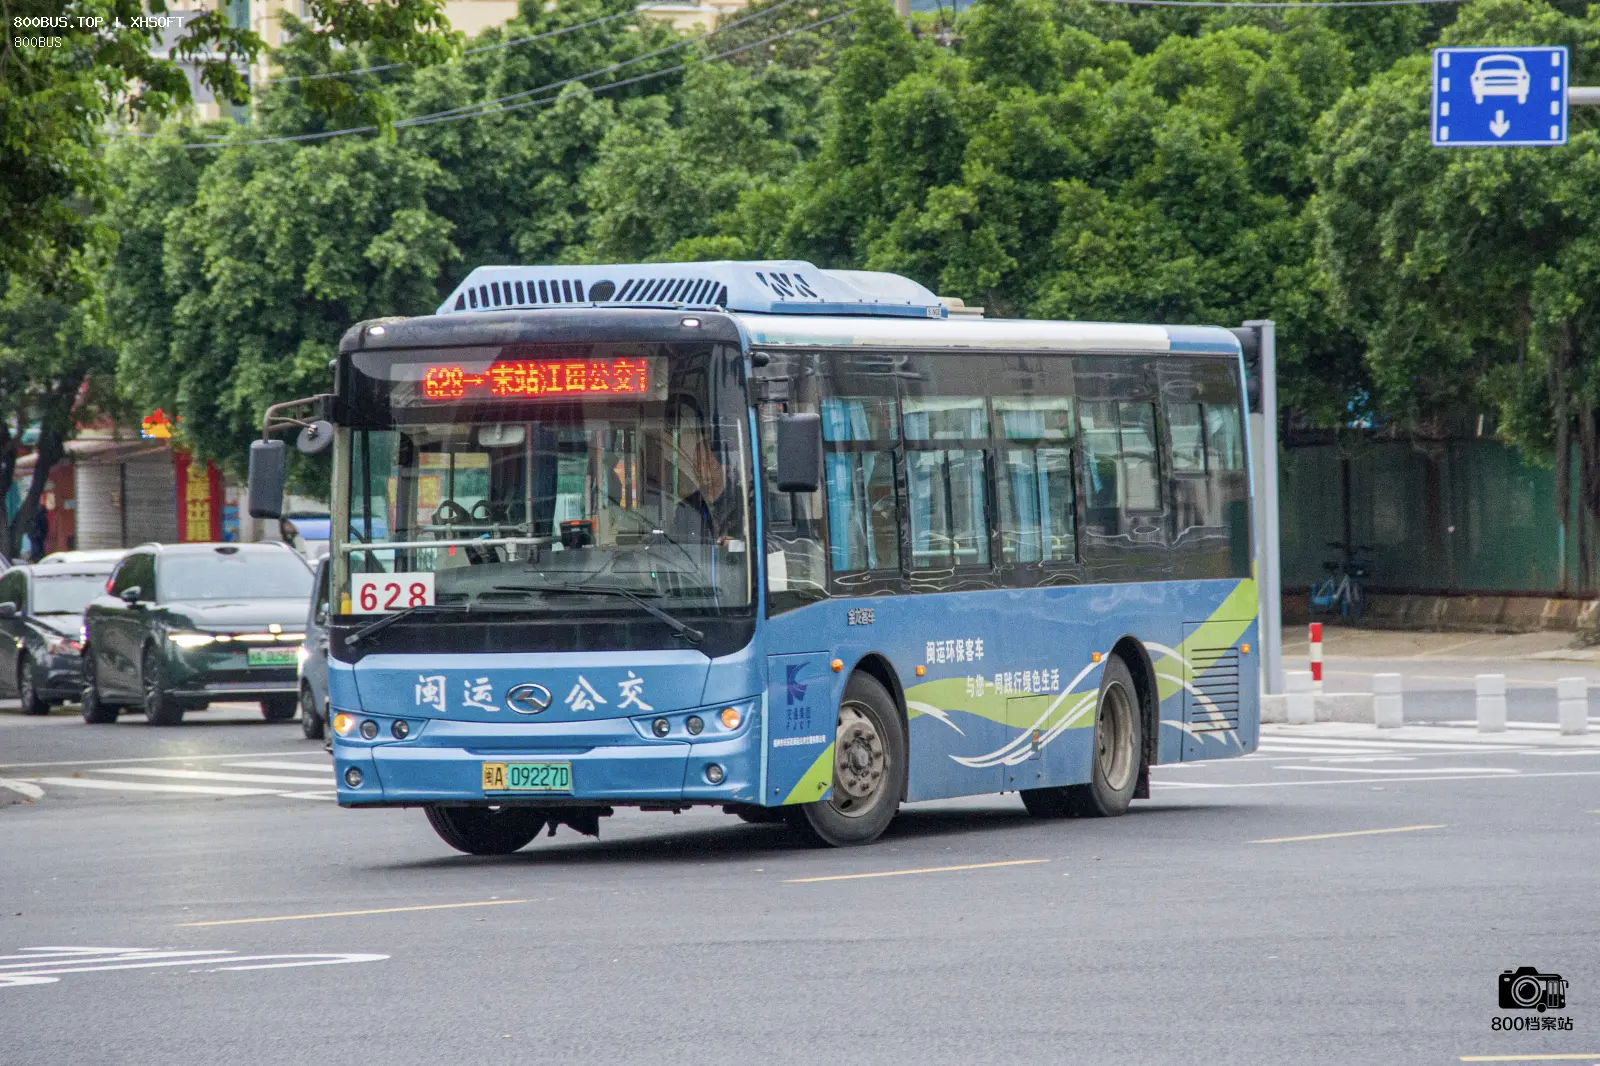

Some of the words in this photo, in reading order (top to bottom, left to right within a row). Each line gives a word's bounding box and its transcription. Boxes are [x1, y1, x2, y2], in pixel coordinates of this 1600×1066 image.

[360, 582, 427, 611] 628
[925, 637, 985, 665] 闽运环保客车
[415, 673, 501, 713] 闽运
[564, 669, 654, 712] 公交
[965, 667, 1060, 698] 与您一同践行绿色生活
[511, 766, 569, 787] 09227D
